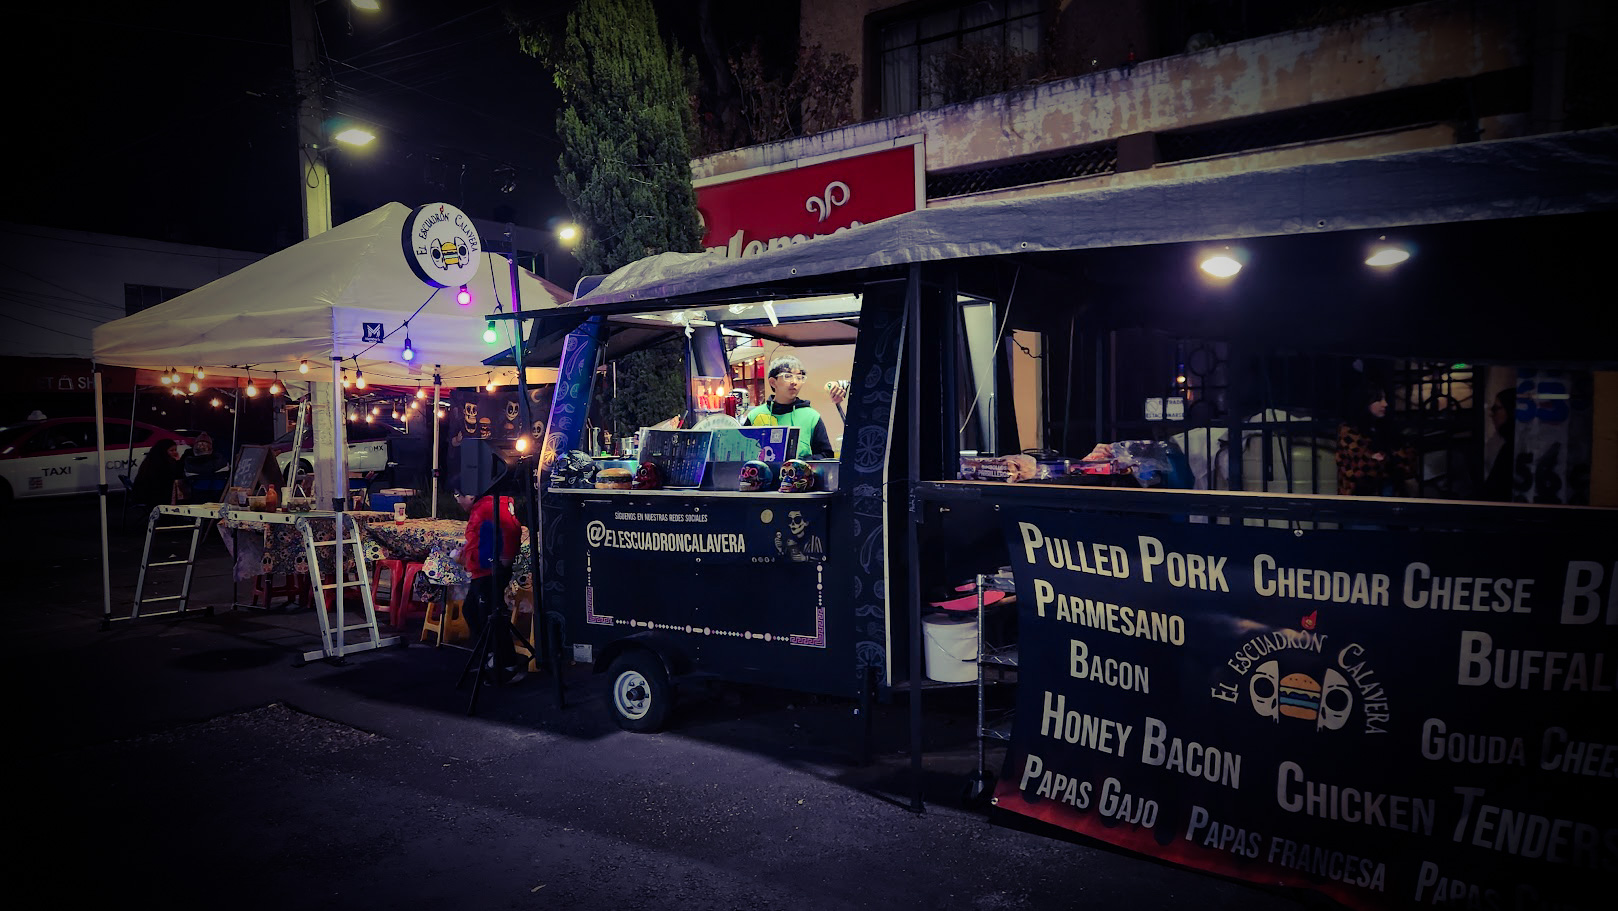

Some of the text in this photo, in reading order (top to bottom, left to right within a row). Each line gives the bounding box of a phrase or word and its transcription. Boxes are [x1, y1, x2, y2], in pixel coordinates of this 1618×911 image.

[416, 246, 428, 256] EL
[454, 214, 478, 253] CALAVERA
[77, 377, 112, 390] SHP
[41, 466, 72, 477] TAXI
[586, 519, 746, 553] @ELESCUADRONCALAVERA
[637, 512, 644, 521] EN
[644, 512, 668, 522] NUESTRAS
[668, 513, 684, 523] REDES
[684, 513, 708, 523] SOCIALES
[1018, 521, 1230, 593] PULLED PORK
[1253, 553, 1535, 614] CHEDDAR CHEESE
[1033, 578, 1186, 647] PARMESANO
[1560, 560, 1618, 626] B
[1069, 638, 1149, 694] BACON
[1211, 682, 1240, 704] EL
[1337, 642, 1391, 734] CALAVERA
[1457, 630, 1618, 693] BUFFAL
[1040, 690, 1242, 790] HONEY BACON
[1421, 717, 1618, 778] GOUDA CHEE
[1019, 753, 1159, 829] PAPAS GAJO
[1277, 760, 1618, 873] CHICKEN TENDERS
[1185, 805, 1386, 893] PAPAS FRANCESA
